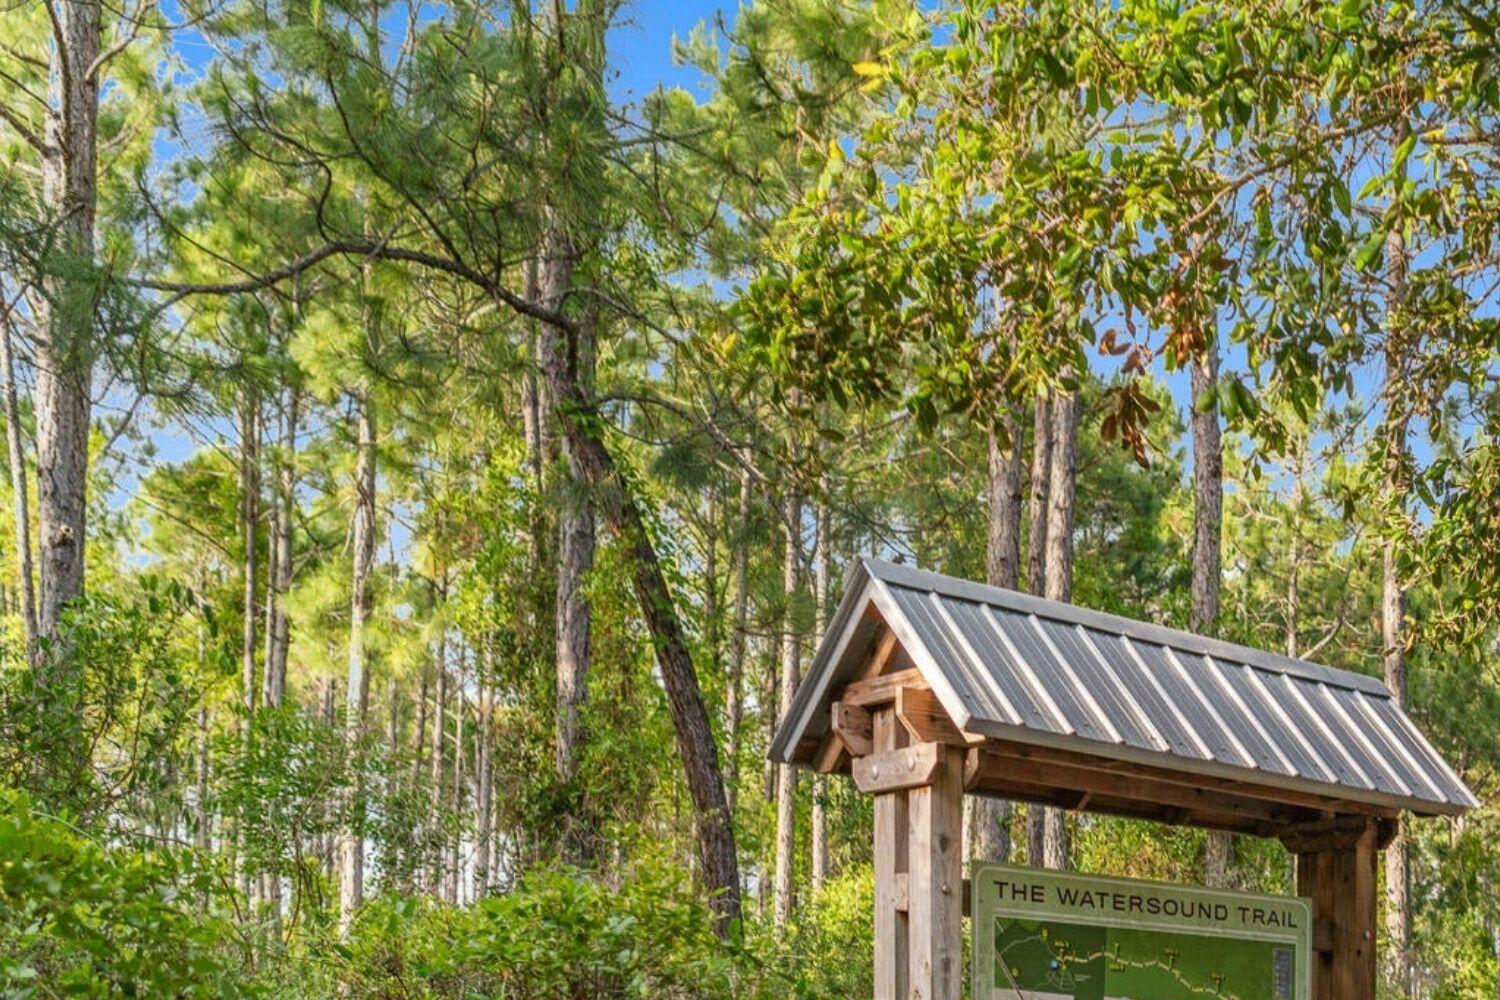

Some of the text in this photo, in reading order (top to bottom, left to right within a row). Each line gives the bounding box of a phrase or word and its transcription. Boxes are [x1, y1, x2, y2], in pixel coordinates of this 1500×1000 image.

[993, 880, 1297, 928] THE WATERSOUND TRAIL
